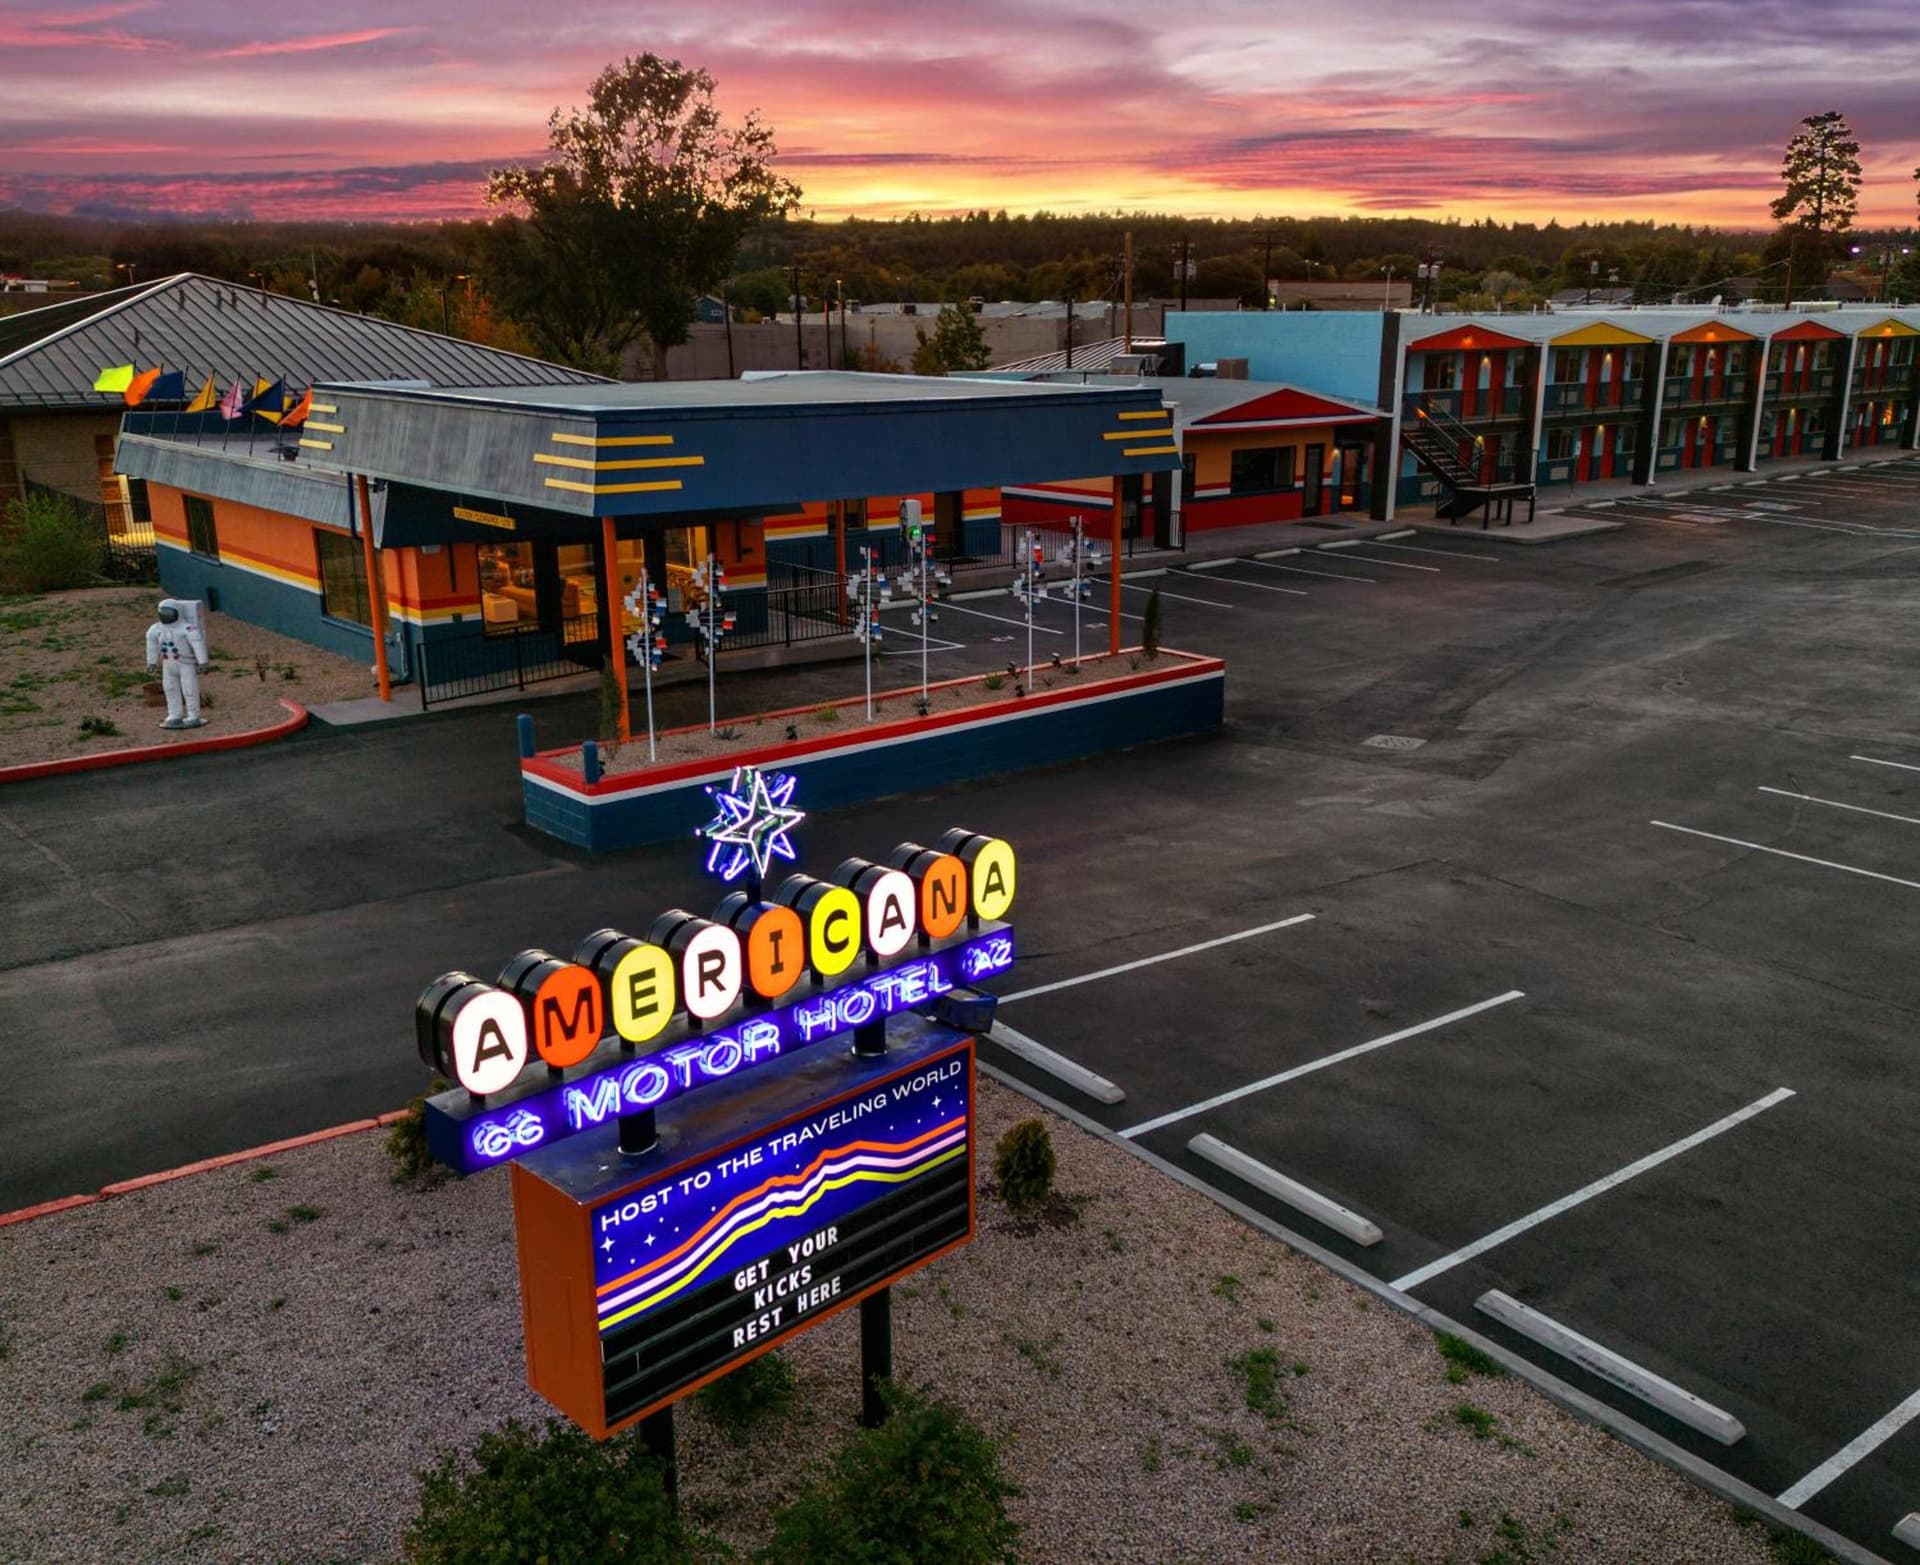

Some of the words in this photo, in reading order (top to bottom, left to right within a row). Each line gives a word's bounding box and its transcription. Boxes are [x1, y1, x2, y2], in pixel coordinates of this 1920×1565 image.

[471, 859, 1007, 1075] AMERICANA
[478, 1112, 544, 1157] 66
[569, 1021, 780, 1129] MOTOR
[799, 962, 953, 1041] HOTEL
[967, 939, 1012, 976] AZ
[600, 1186, 673, 1231] HOST
[679, 1170, 712, 1196] TO
[717, 1151, 763, 1179] THE
[767, 1094, 888, 1156] TRAVELING
[892, 1060, 962, 1101] WORLD
[733, 1258, 769, 1291] GET
[788, 1226, 838, 1264] YOUR
[733, 1306, 783, 1348] REST
[797, 1276, 841, 1313] HERE
[754, 1265, 812, 1310] KICKS
